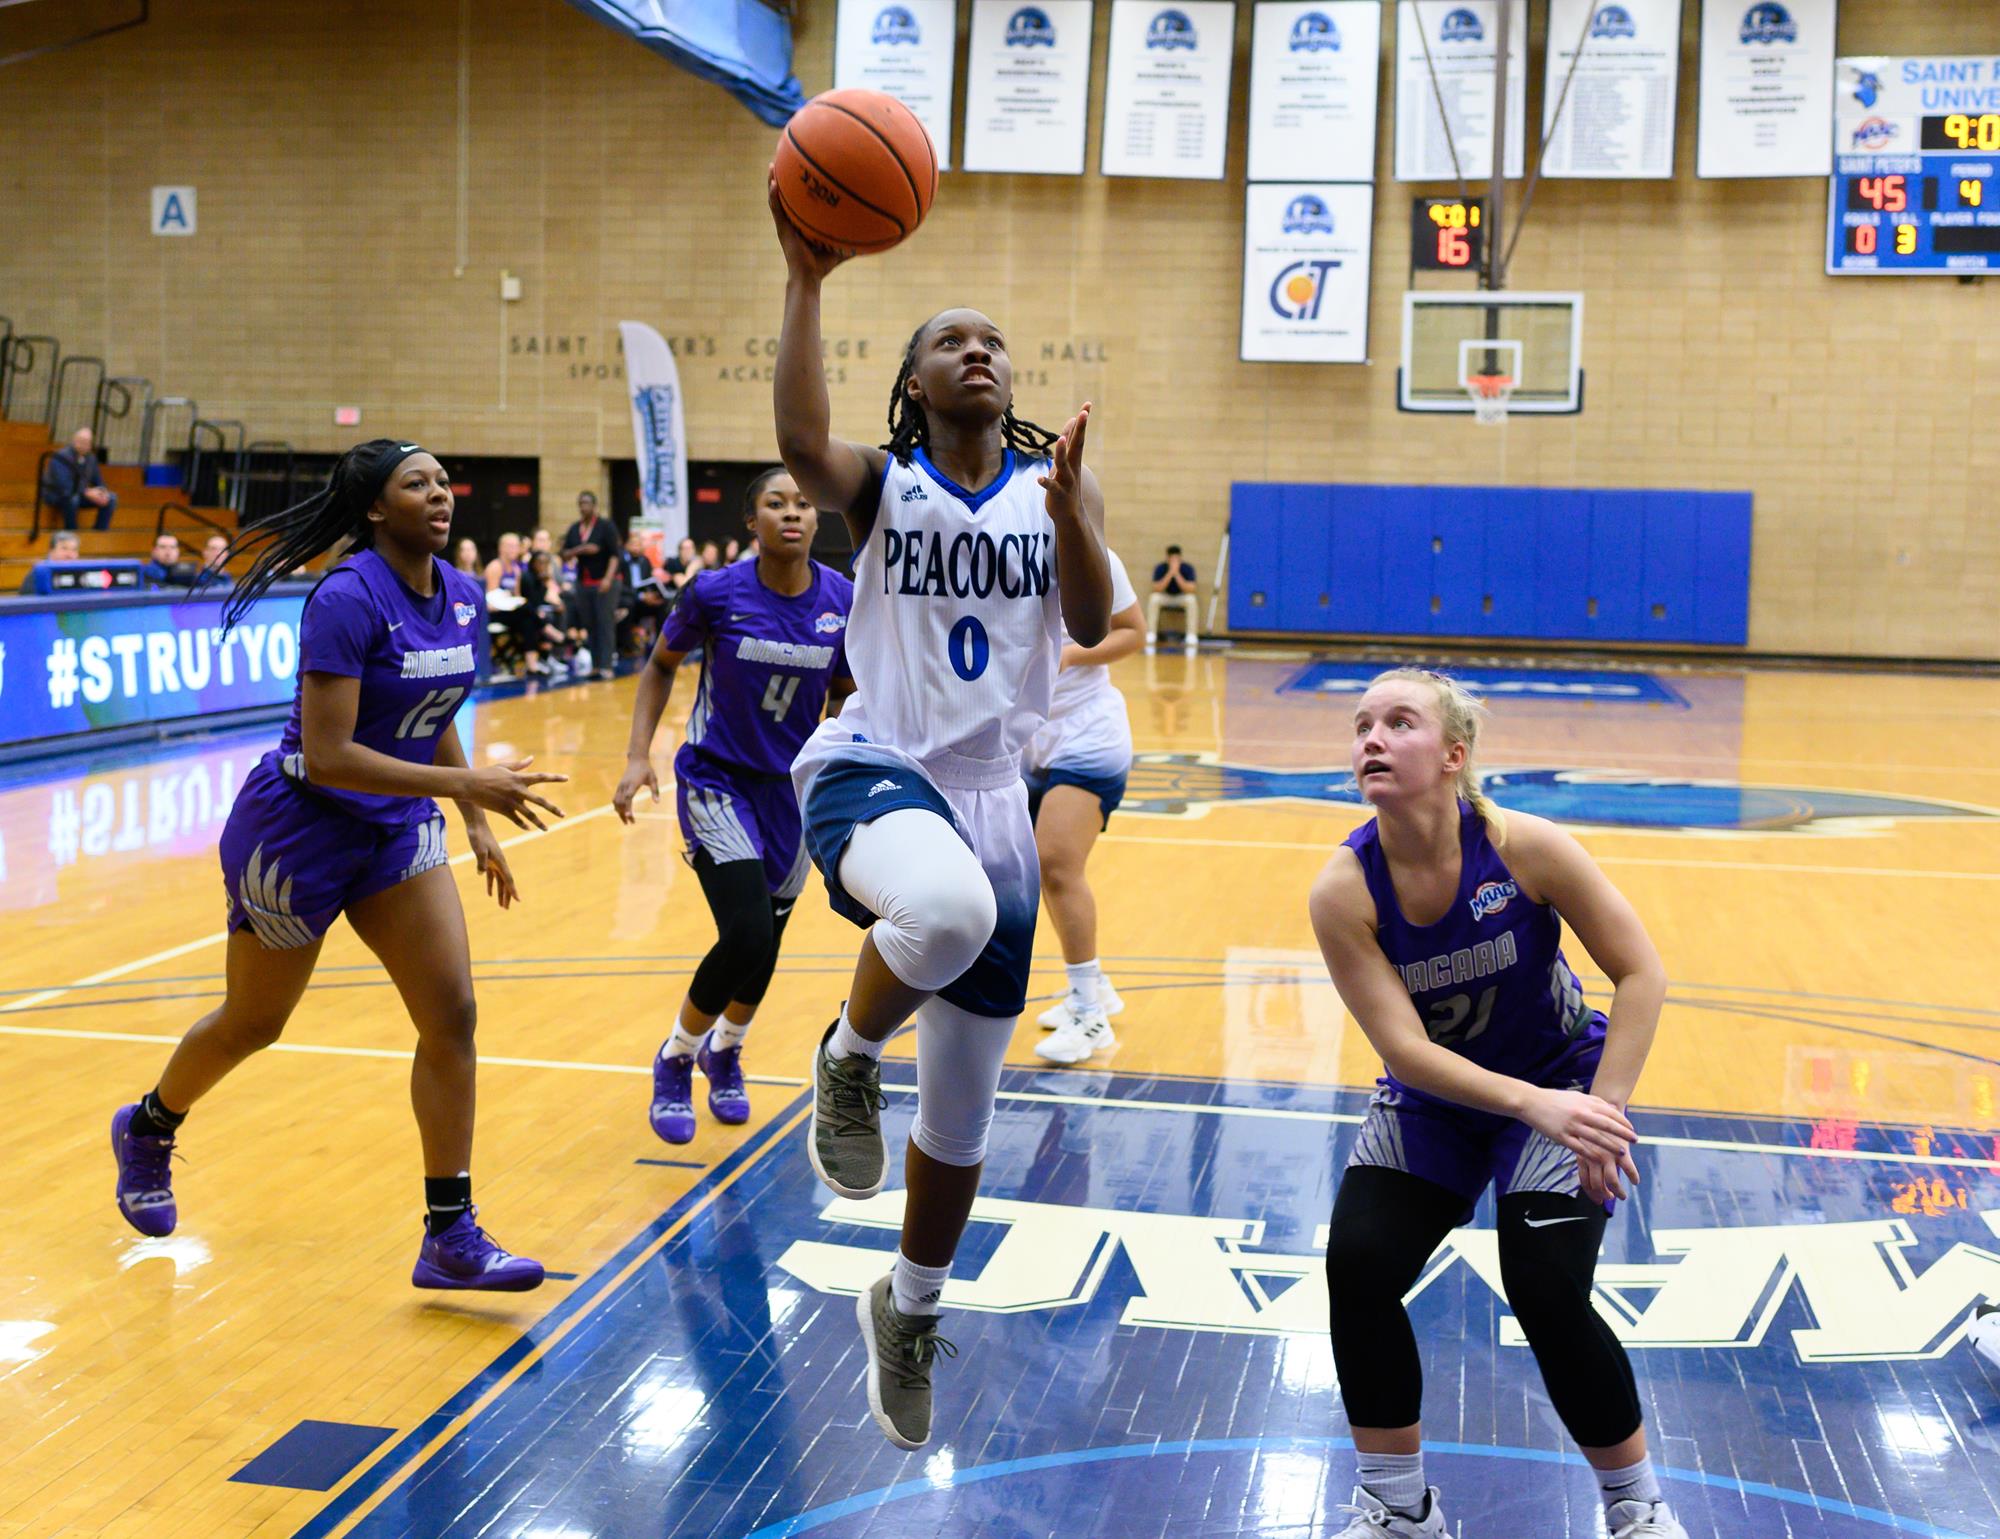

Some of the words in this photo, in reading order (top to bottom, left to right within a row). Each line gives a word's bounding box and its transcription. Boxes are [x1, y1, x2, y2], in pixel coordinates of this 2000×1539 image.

[1902, 60, 1984, 84] SAINT
[1921, 87, 2000, 109] UNIVE
[160, 192, 188, 228] A
[1859, 174, 1907, 213] 45
[1959, 179, 1982, 207] 4
[1429, 203, 1480, 228] 9:01
[1438, 227, 1471, 266] 16
[1855, 223, 1877, 255] 0
[1896, 223, 1918, 255] 3
[510, 334, 587, 355] SAINT
[743, 337, 871, 361] COGE
[1040, 340, 1110, 363] HALL
[717, 366, 848, 386] ACADCS
[46, 621, 300, 709] #STRUTYO
[401, 643, 476, 679] NIAGARA
[736, 636, 834, 670] NIAGARA
[948, 615, 990, 682] 0
[394, 686, 465, 739] 12
[761, 674, 801, 722] 4
[1469, 881, 1518, 919] MAAC
[1393, 930, 1518, 994] AGARA
[1427, 985, 1499, 1045] 21
